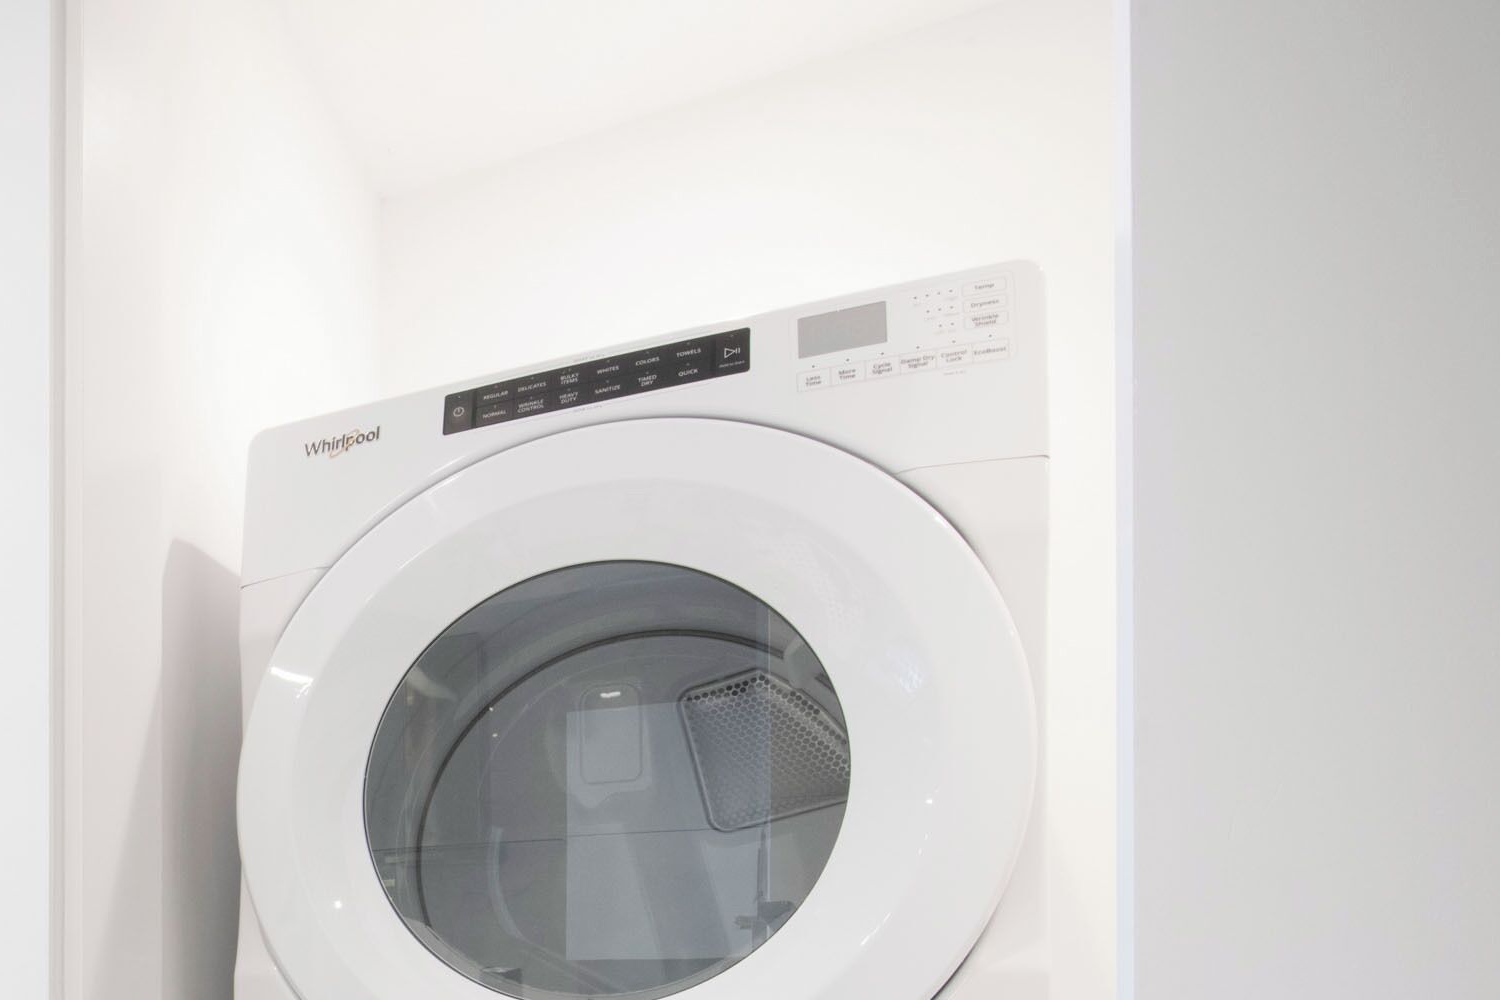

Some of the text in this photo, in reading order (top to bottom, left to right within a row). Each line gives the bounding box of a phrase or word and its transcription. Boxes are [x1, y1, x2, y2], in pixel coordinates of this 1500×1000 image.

[971, 300, 999, 308] Dryness
[676, 348, 702, 358] TOWELS
[940, 349, 967, 358] Control
[635, 356, 660, 366] COLORS
[908, 361, 929, 369] Signal
[597, 365, 619, 375] WHITES
[678, 368, 699, 377] QUICK
[838, 368, 856, 376] More
[871, 367, 893, 375] Signal
[560, 372, 580, 382] BULKY
[560, 377, 579, 385] ITEMS
[638, 374, 658, 383] TIMED
[517, 381, 547, 392] DELICATES
[640, 379, 654, 387] DRY
[594, 384, 621, 394] SANITIZE
[483, 390, 509, 400] REGULAR
[559, 391, 579, 400] HEAVY
[518, 398, 544, 408] WRINKLE
[560, 396, 578, 405] DUTY
[517, 403, 545, 413] CONTROL
[482, 410, 507, 419] NORMAL
[305, 426, 380, 457] Whirlpool
